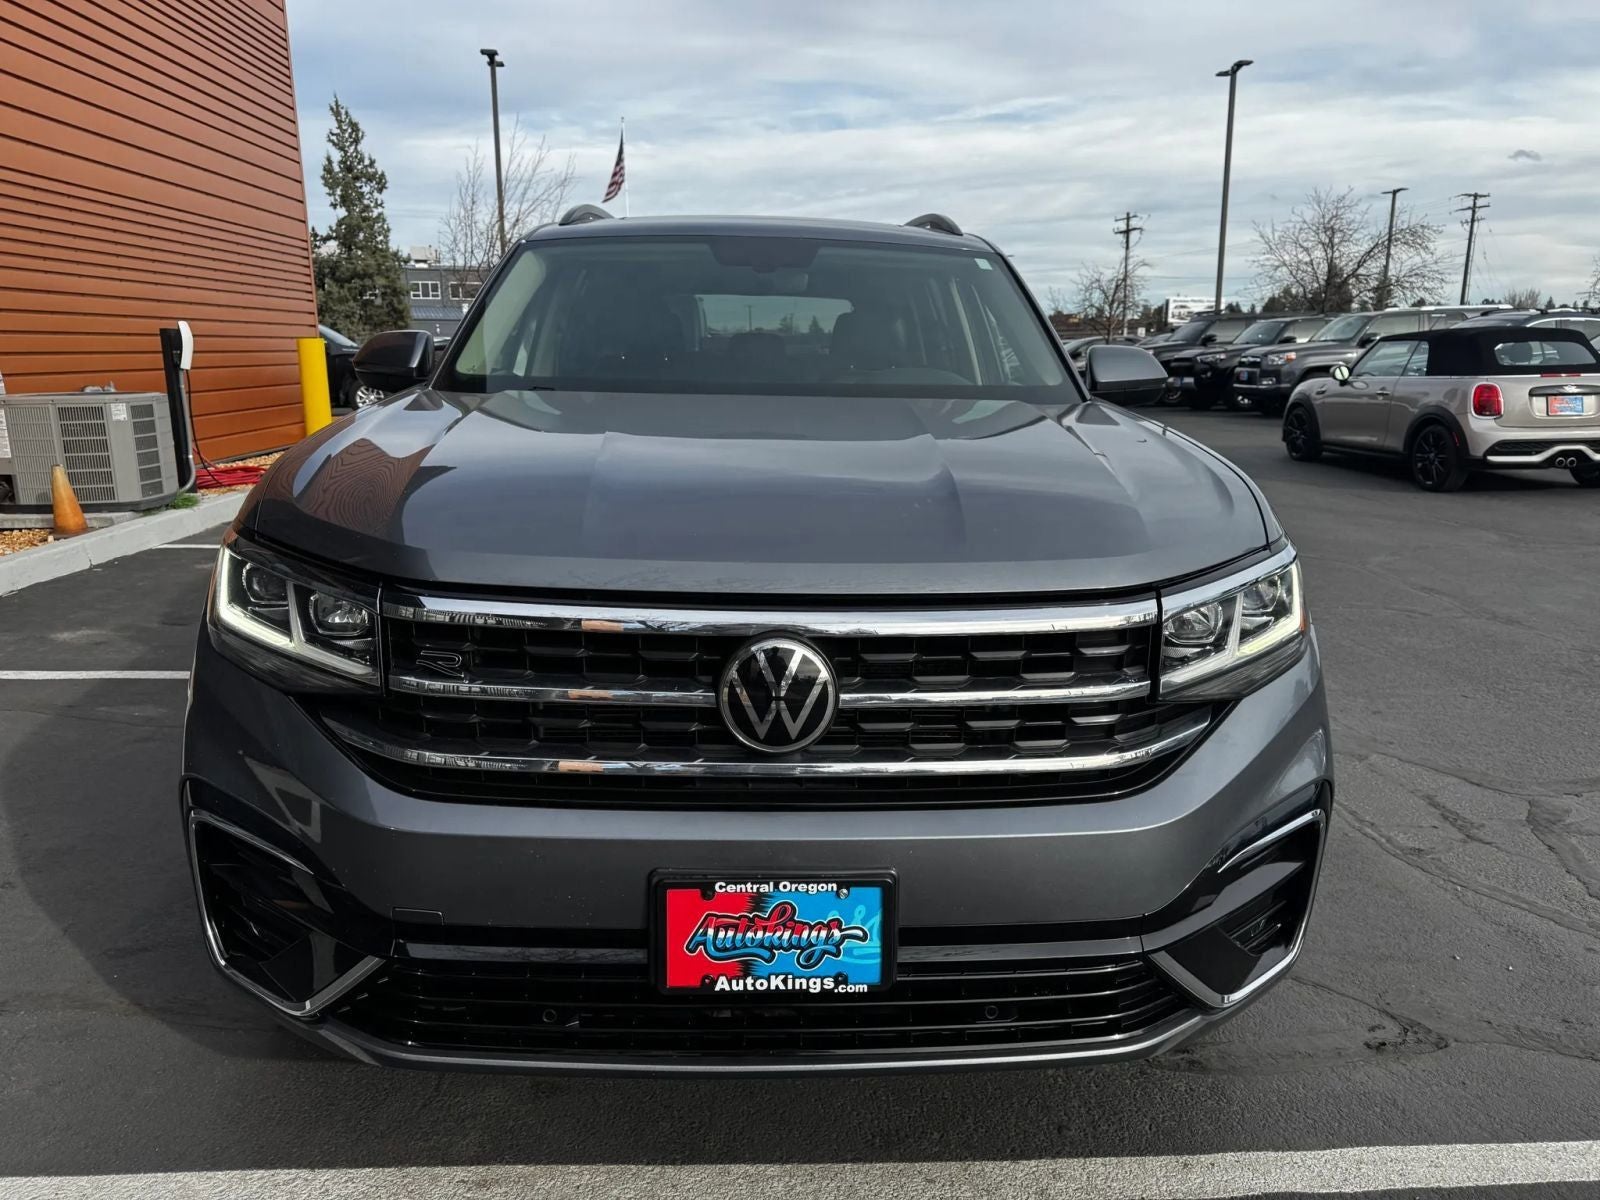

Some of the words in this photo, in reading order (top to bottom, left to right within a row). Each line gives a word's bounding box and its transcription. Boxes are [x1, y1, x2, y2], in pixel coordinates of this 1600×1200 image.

[728, 645, 832, 744] VW
[714, 881, 774, 893] Central
[778, 881, 838, 895] Oregon
[714, 974, 868, 993] AutoKings.com
